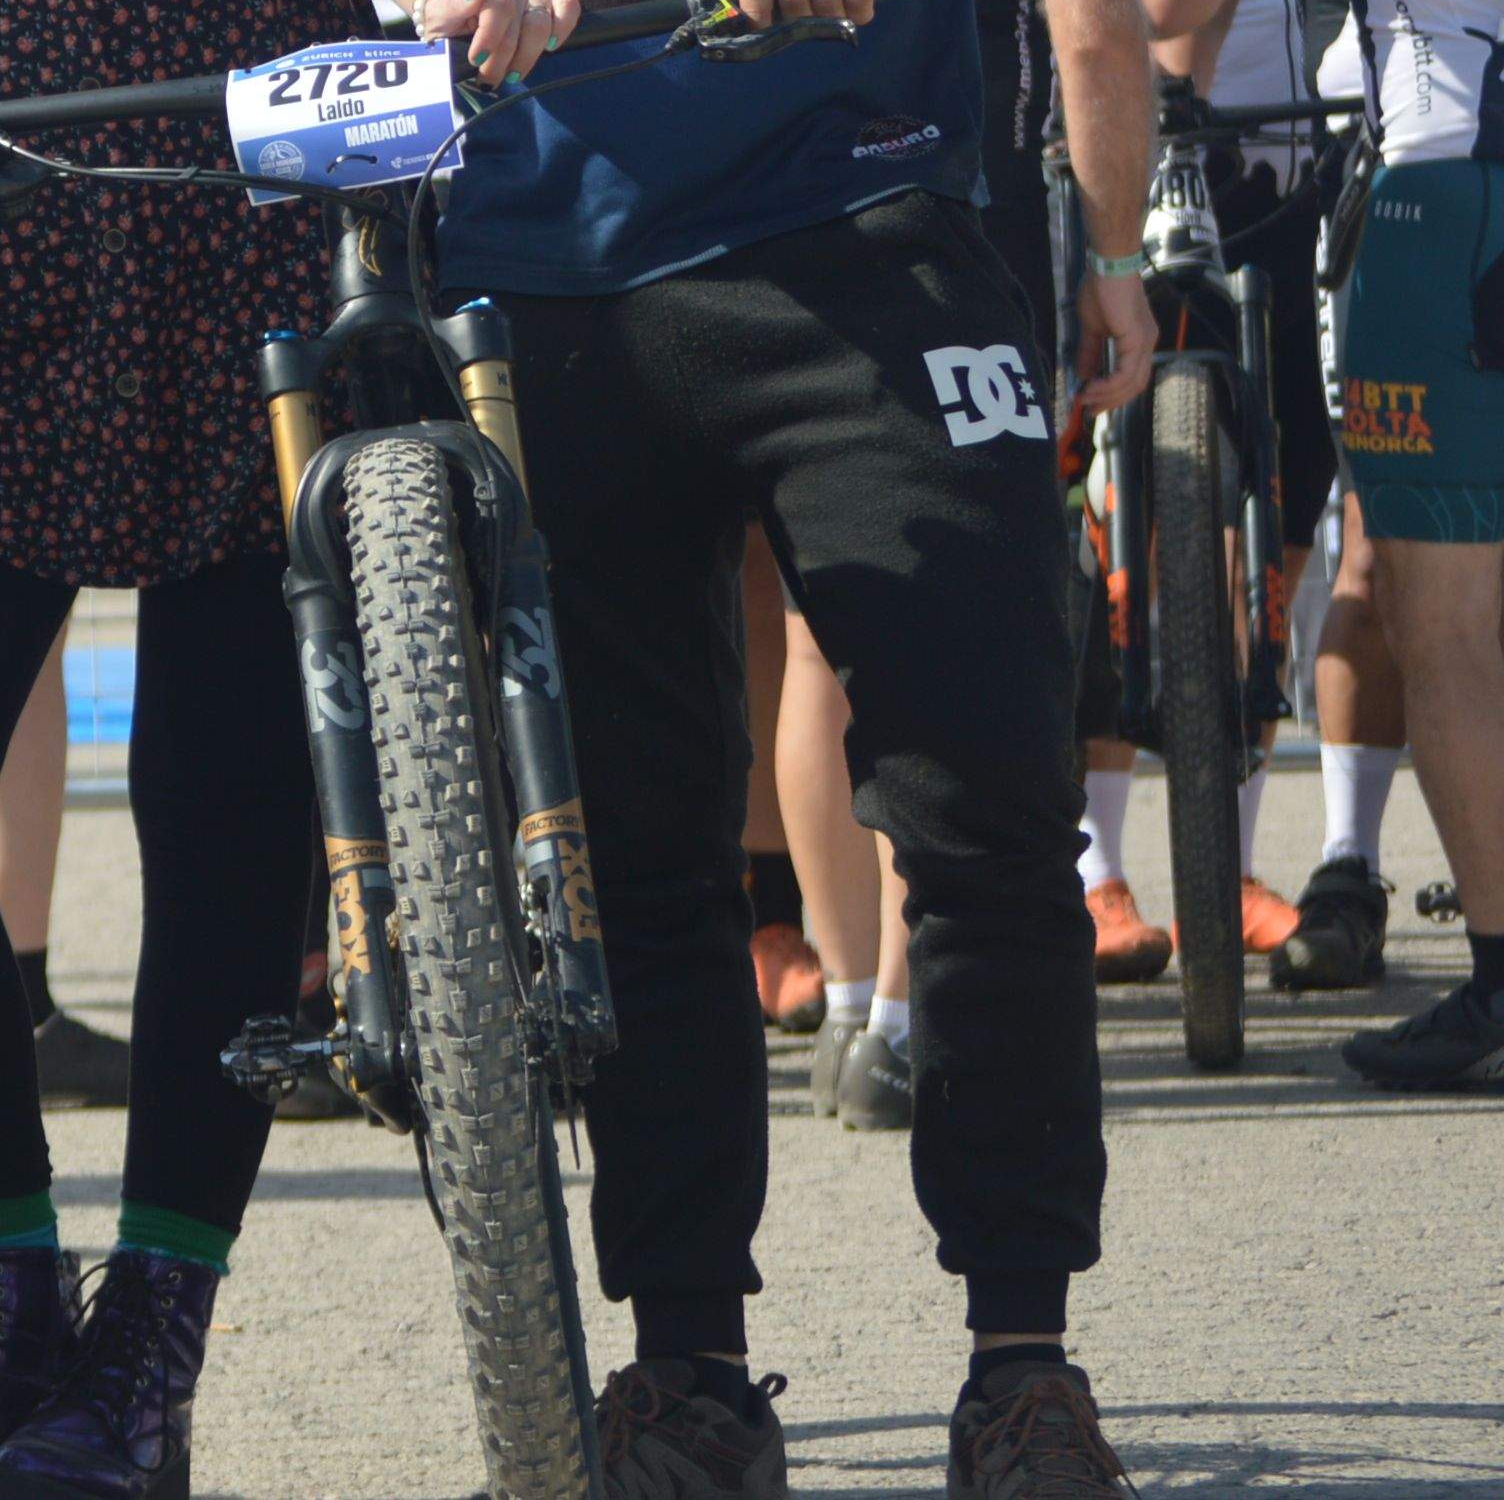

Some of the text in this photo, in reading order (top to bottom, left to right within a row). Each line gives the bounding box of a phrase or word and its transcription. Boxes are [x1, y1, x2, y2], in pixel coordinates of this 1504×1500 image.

[268, 59, 409, 108] 2720
[318, 99, 365, 122] Laldo
[344, 114, 419, 148] MARATÓN
[923, 344, 1049, 448] DC
[1345, 410, 1431, 440] OLTA
[525, 811, 582, 837] FACTORY
[329, 840, 388, 868] FACTORY
[556, 838, 603, 942] FOX
[332, 870, 371, 980] FOX
